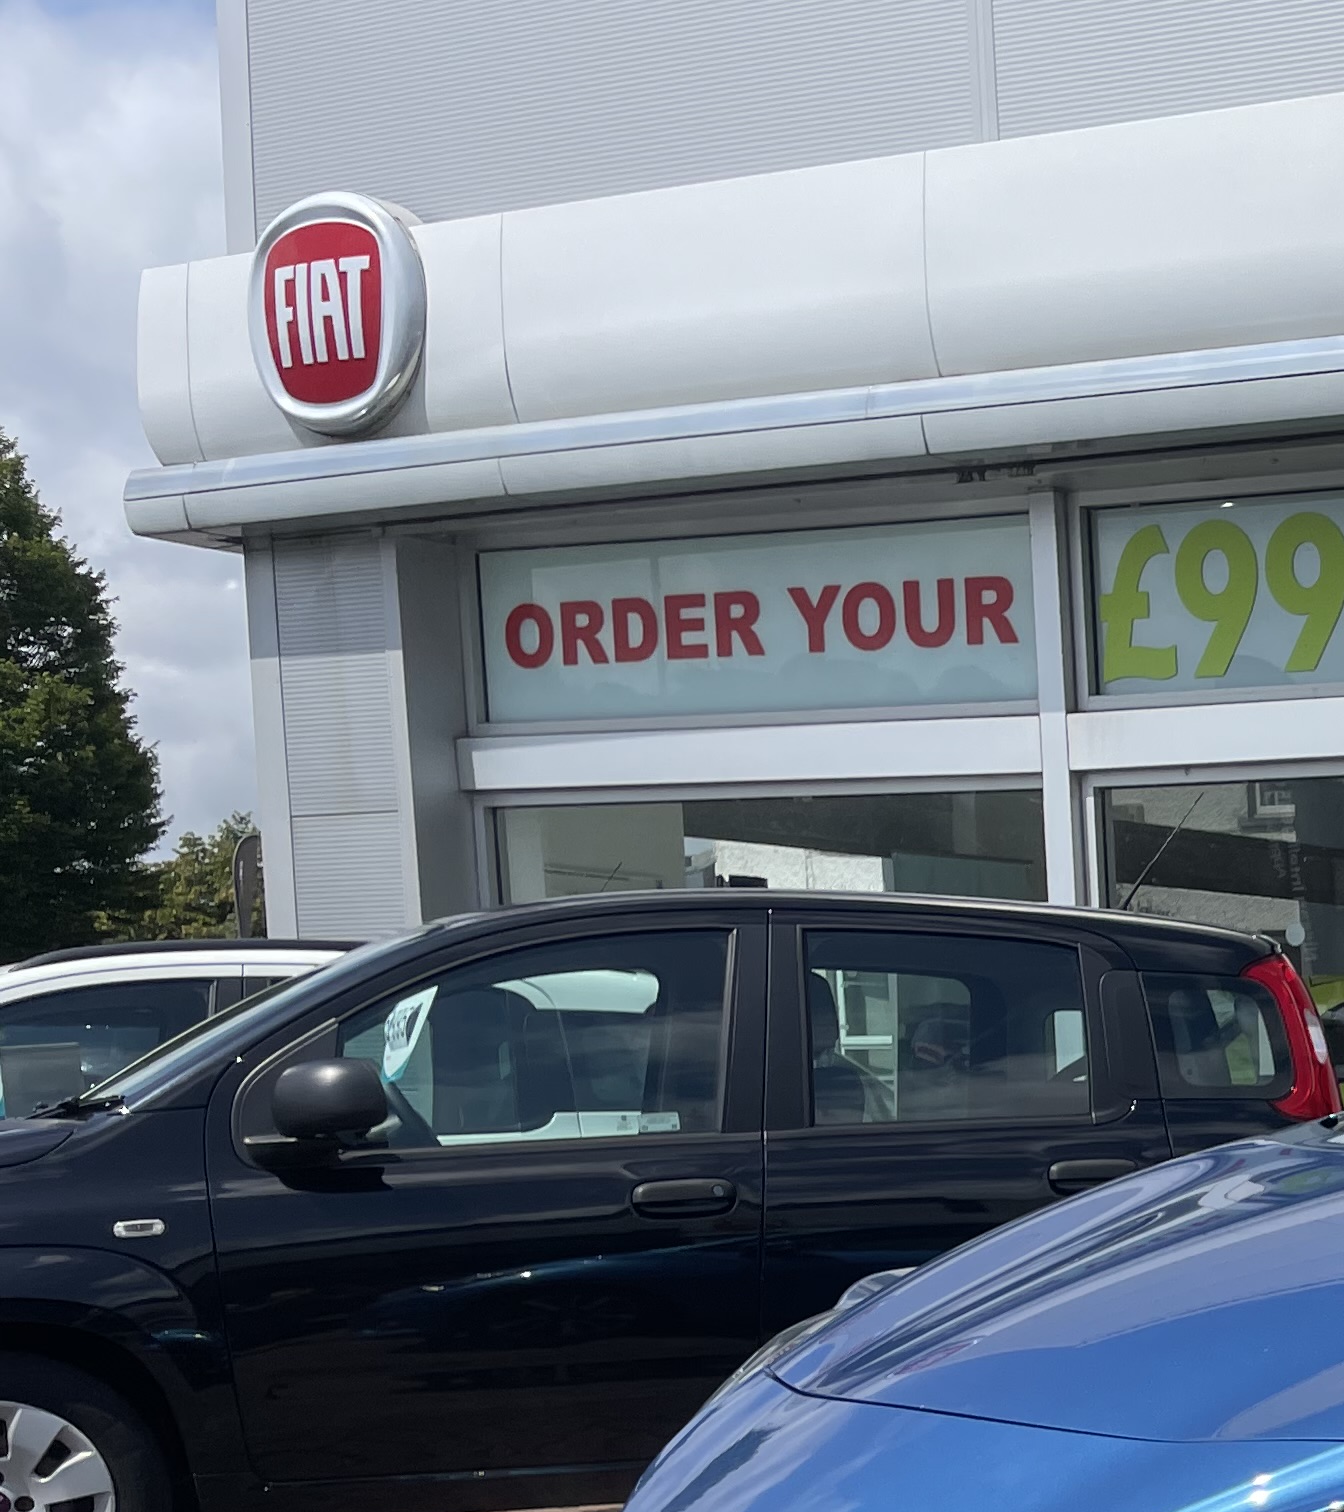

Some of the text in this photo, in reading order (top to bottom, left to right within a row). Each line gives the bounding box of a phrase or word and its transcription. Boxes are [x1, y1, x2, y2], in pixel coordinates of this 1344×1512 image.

[273, 254, 371, 369] FIAT
[504, 576, 1020, 669] ORDER YOUR
